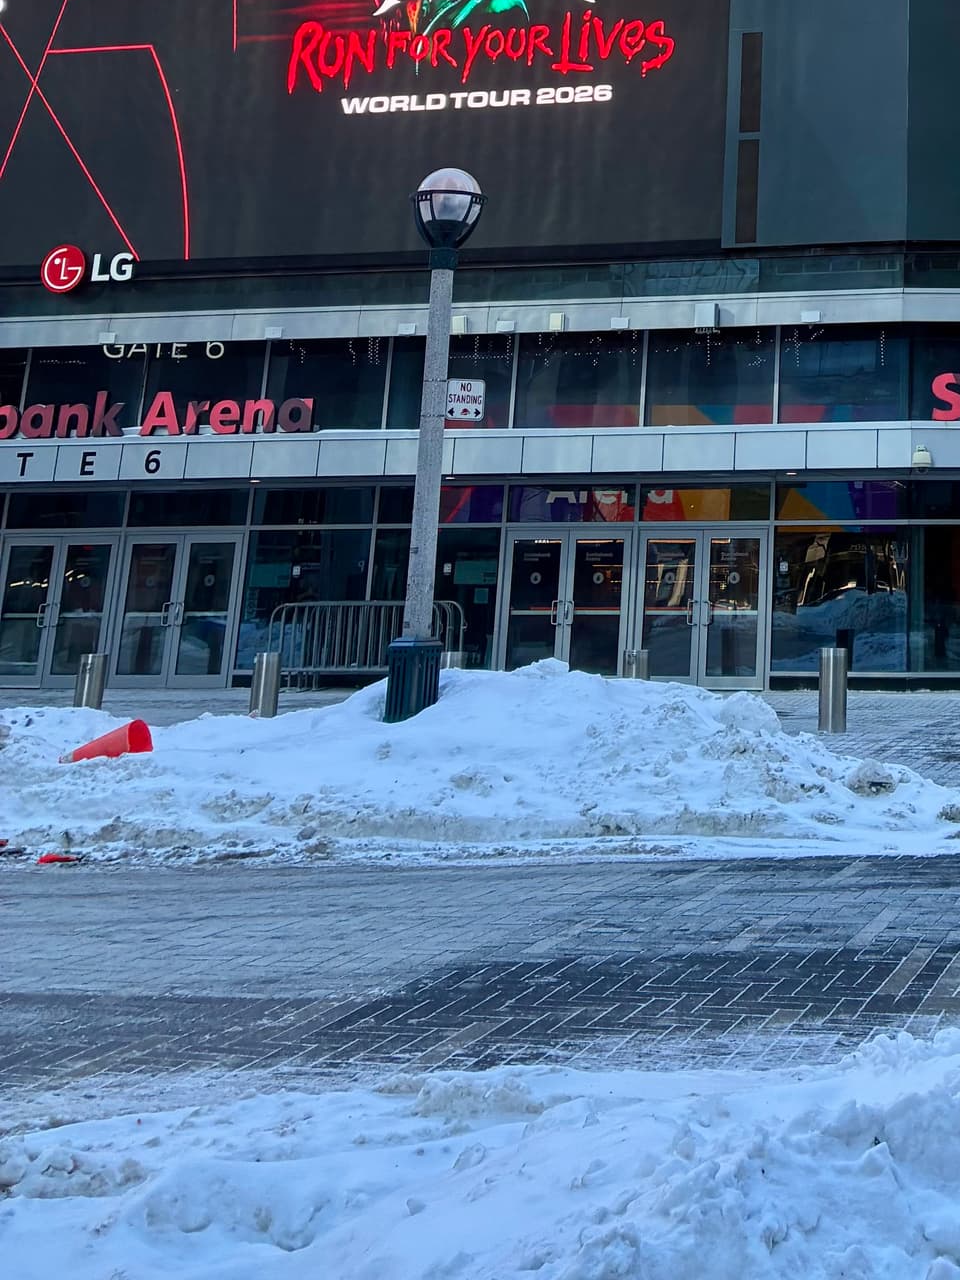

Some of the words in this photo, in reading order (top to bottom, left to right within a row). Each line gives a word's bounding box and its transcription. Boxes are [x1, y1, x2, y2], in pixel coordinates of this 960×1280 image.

[286, 21, 376, 96] RUN
[386, 27, 459, 69] FOR
[461, 23, 554, 85] YOUR
[340, 93, 447, 115] WORLD
[448, 87, 531, 109] TOUR
[535, 84, 614, 105] 2026
[91, 252, 135, 282] LG
[448, 393, 483, 405] STANDING
[460, 382, 472, 392] NO
[138, 390, 316, 436] Arena
[144, 450, 162, 475] 6
